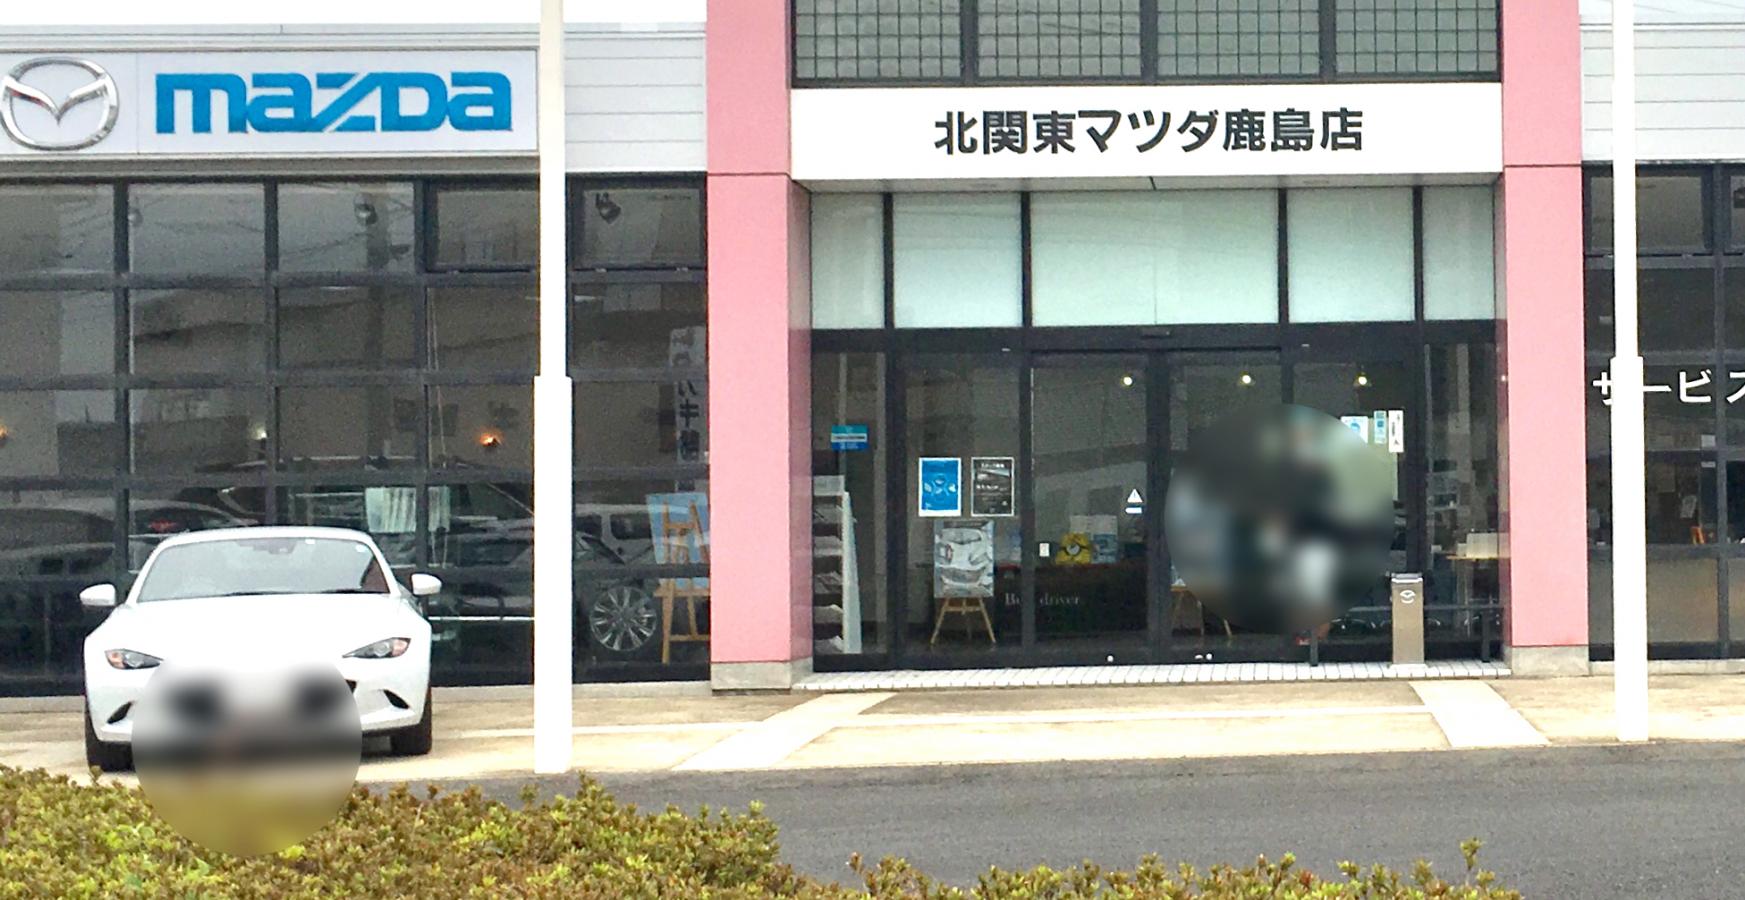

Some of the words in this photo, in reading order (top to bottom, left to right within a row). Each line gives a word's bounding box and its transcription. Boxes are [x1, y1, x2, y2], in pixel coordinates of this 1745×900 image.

[934, 108, 1364, 154] 北関東マツダ鹿島店
[1039, 591, 1081, 606] driver
